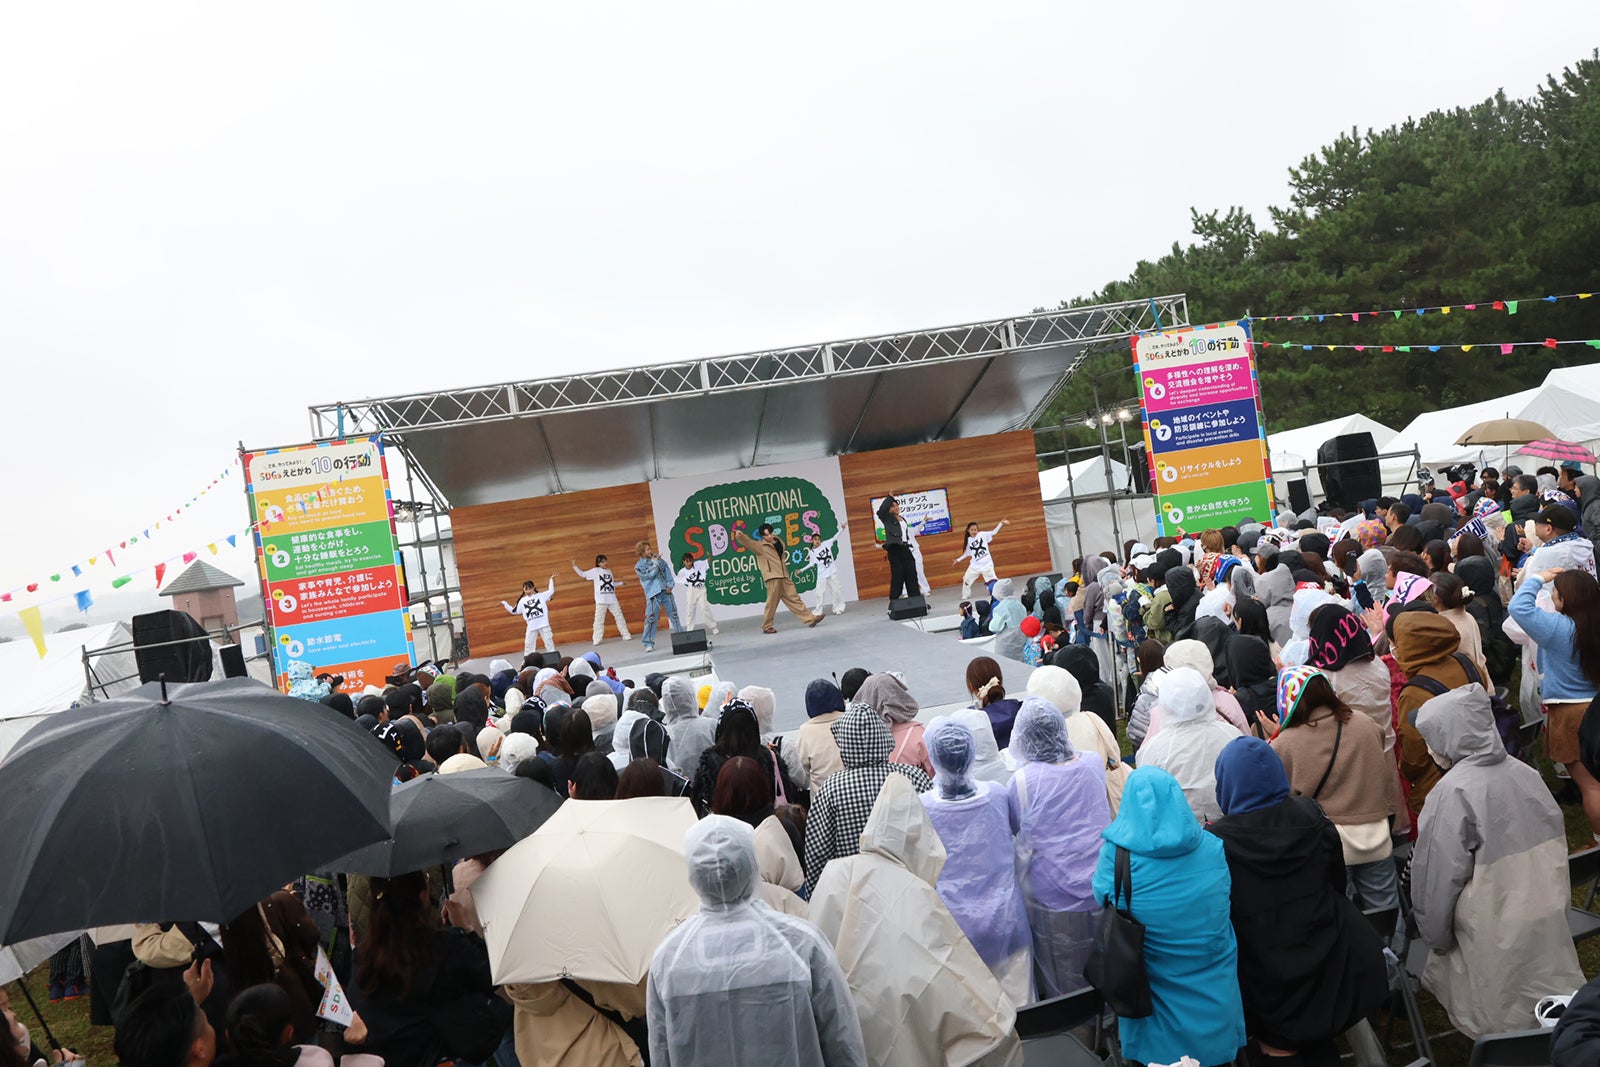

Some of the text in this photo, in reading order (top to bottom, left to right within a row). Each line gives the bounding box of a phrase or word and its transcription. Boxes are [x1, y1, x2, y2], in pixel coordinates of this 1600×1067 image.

[1168, 373, 1233, 389] 交流機会を増やそう
[1155, 388, 1161, 396] 6
[1173, 409, 1230, 424] 地域のイベントや
[1174, 416, 1246, 433] 防災訓練に参加しよう
[1161, 429, 1167, 437] 7
[1180, 458, 1242, 473] リサイクルをしよう
[1167, 470, 1174, 479] 8
[697, 487, 809, 522] INTERNATIONAL
[900, 503, 940, 513] ショップショー
[1187, 497, 1250, 513] 豊かな自然を守ろう
[1173, 512, 1180, 520] 9
[291, 527, 363, 544] 健康的な食事をし、
[293, 539, 348, 554] 運動を心がけ、
[278, 555, 285, 564] 2
[294, 546, 370, 563] 十分な睡眠をとろう
[712, 547, 810, 577] EDOGA 202
[298, 573, 374, 590] 家事や育児、介護に
[709, 576, 745, 587] Supported
[745, 574, 756, 584] by
[300, 580, 394, 601] 家族みんなで参加しよう
[716, 583, 750, 596] TGC
[284, 600, 292, 608] 3
[307, 634, 342, 646] 節水節電
[291, 645, 299, 654] 4
